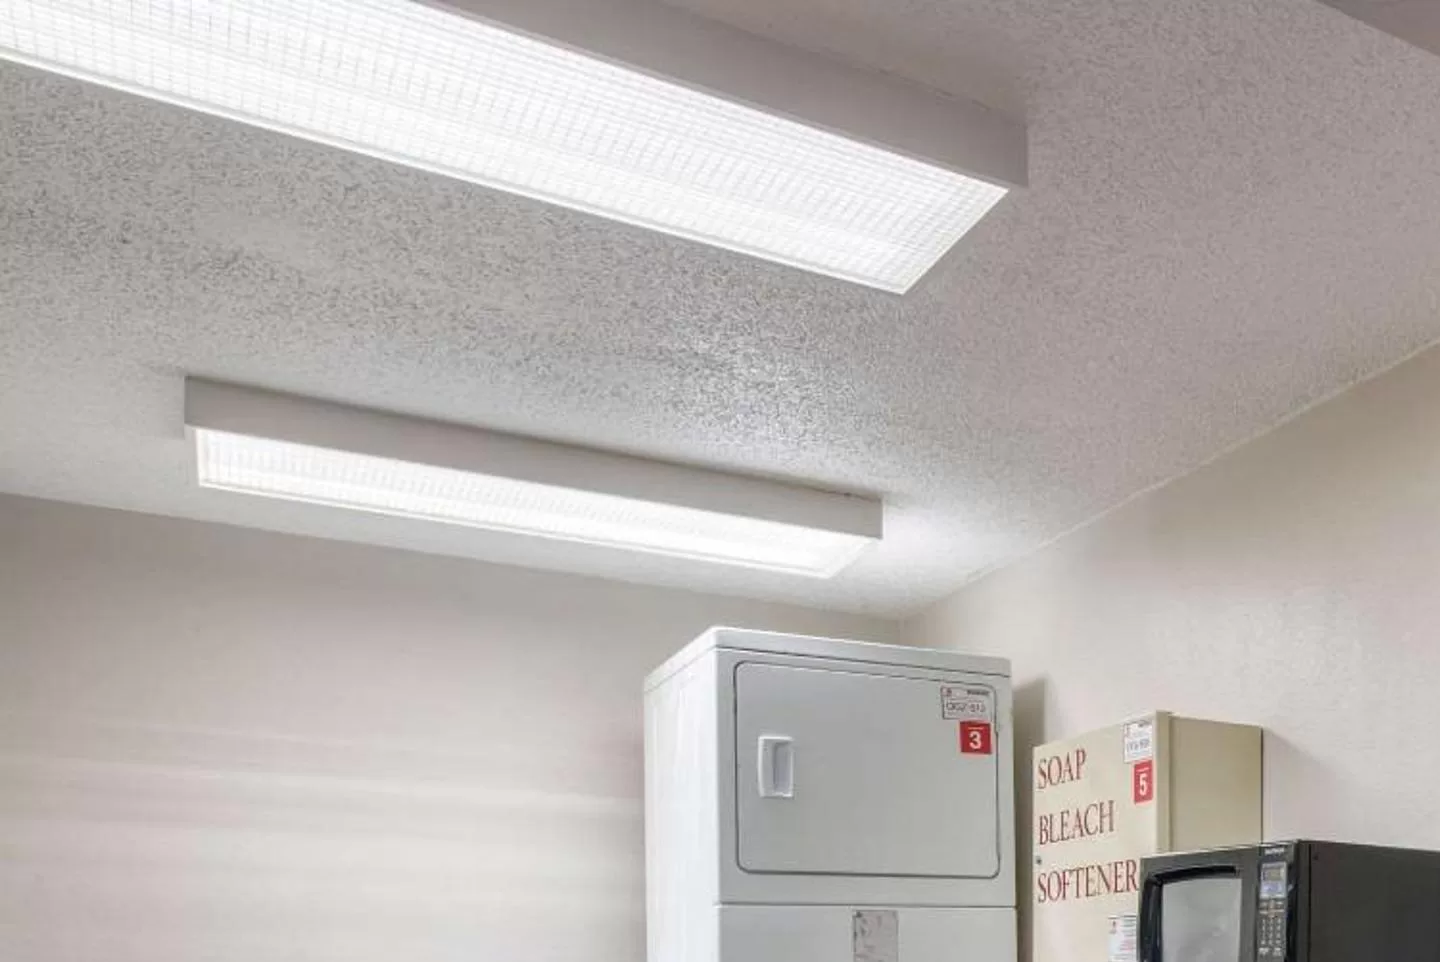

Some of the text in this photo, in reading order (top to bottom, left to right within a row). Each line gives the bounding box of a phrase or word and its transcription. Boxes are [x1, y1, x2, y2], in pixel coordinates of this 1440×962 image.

[969, 730, 982, 750] 3
[1038, 748, 1086, 790] SOAP
[1139, 773, 1148, 796] 5
[1039, 800, 1115, 846] BLEACH
[1038, 859, 1140, 904] SOFTENER
